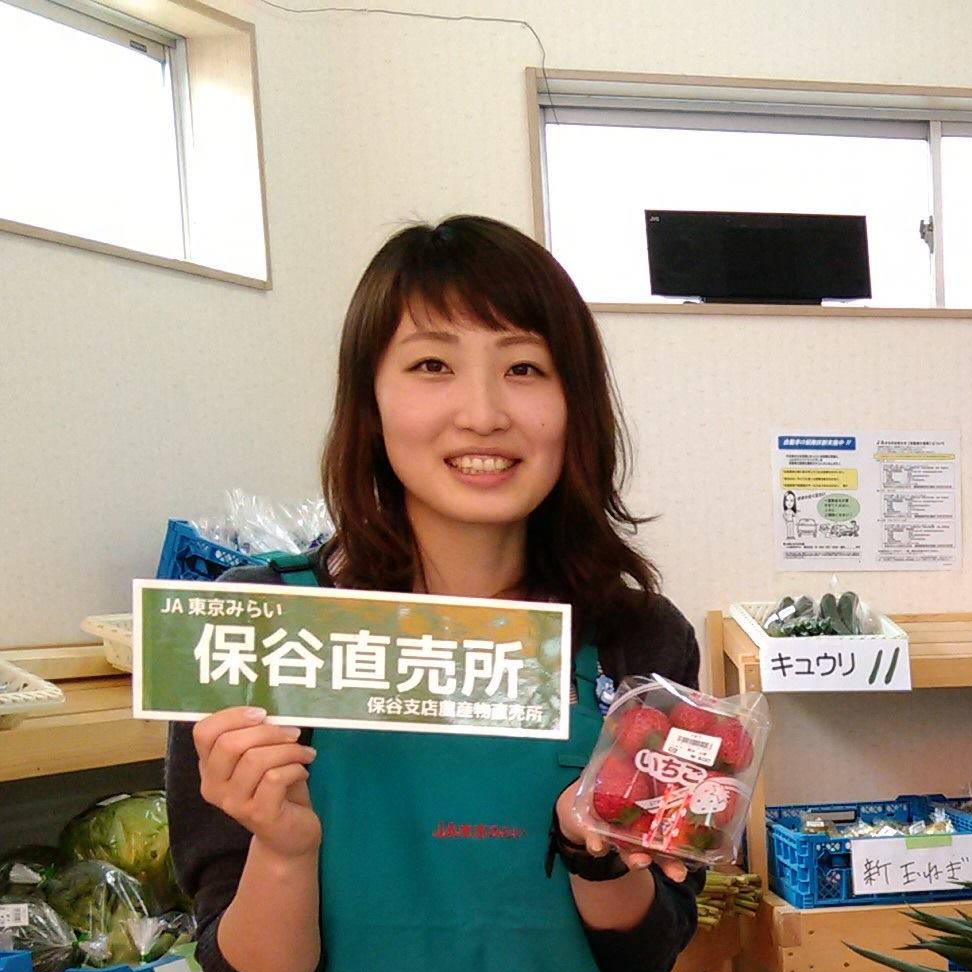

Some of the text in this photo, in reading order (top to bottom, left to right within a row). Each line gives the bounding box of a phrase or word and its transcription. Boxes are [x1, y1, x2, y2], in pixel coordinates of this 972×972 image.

[160, 597, 283, 618] JA 東京みらい
[193, 622, 525, 699] 保谷直売所
[771, 652, 855, 677] キュウリ
[367, 696, 543, 722] 保谷支店農産物直売所
[639, 751, 704, 784] いちご
[863, 857, 969, 886] 新玉ねぎ
